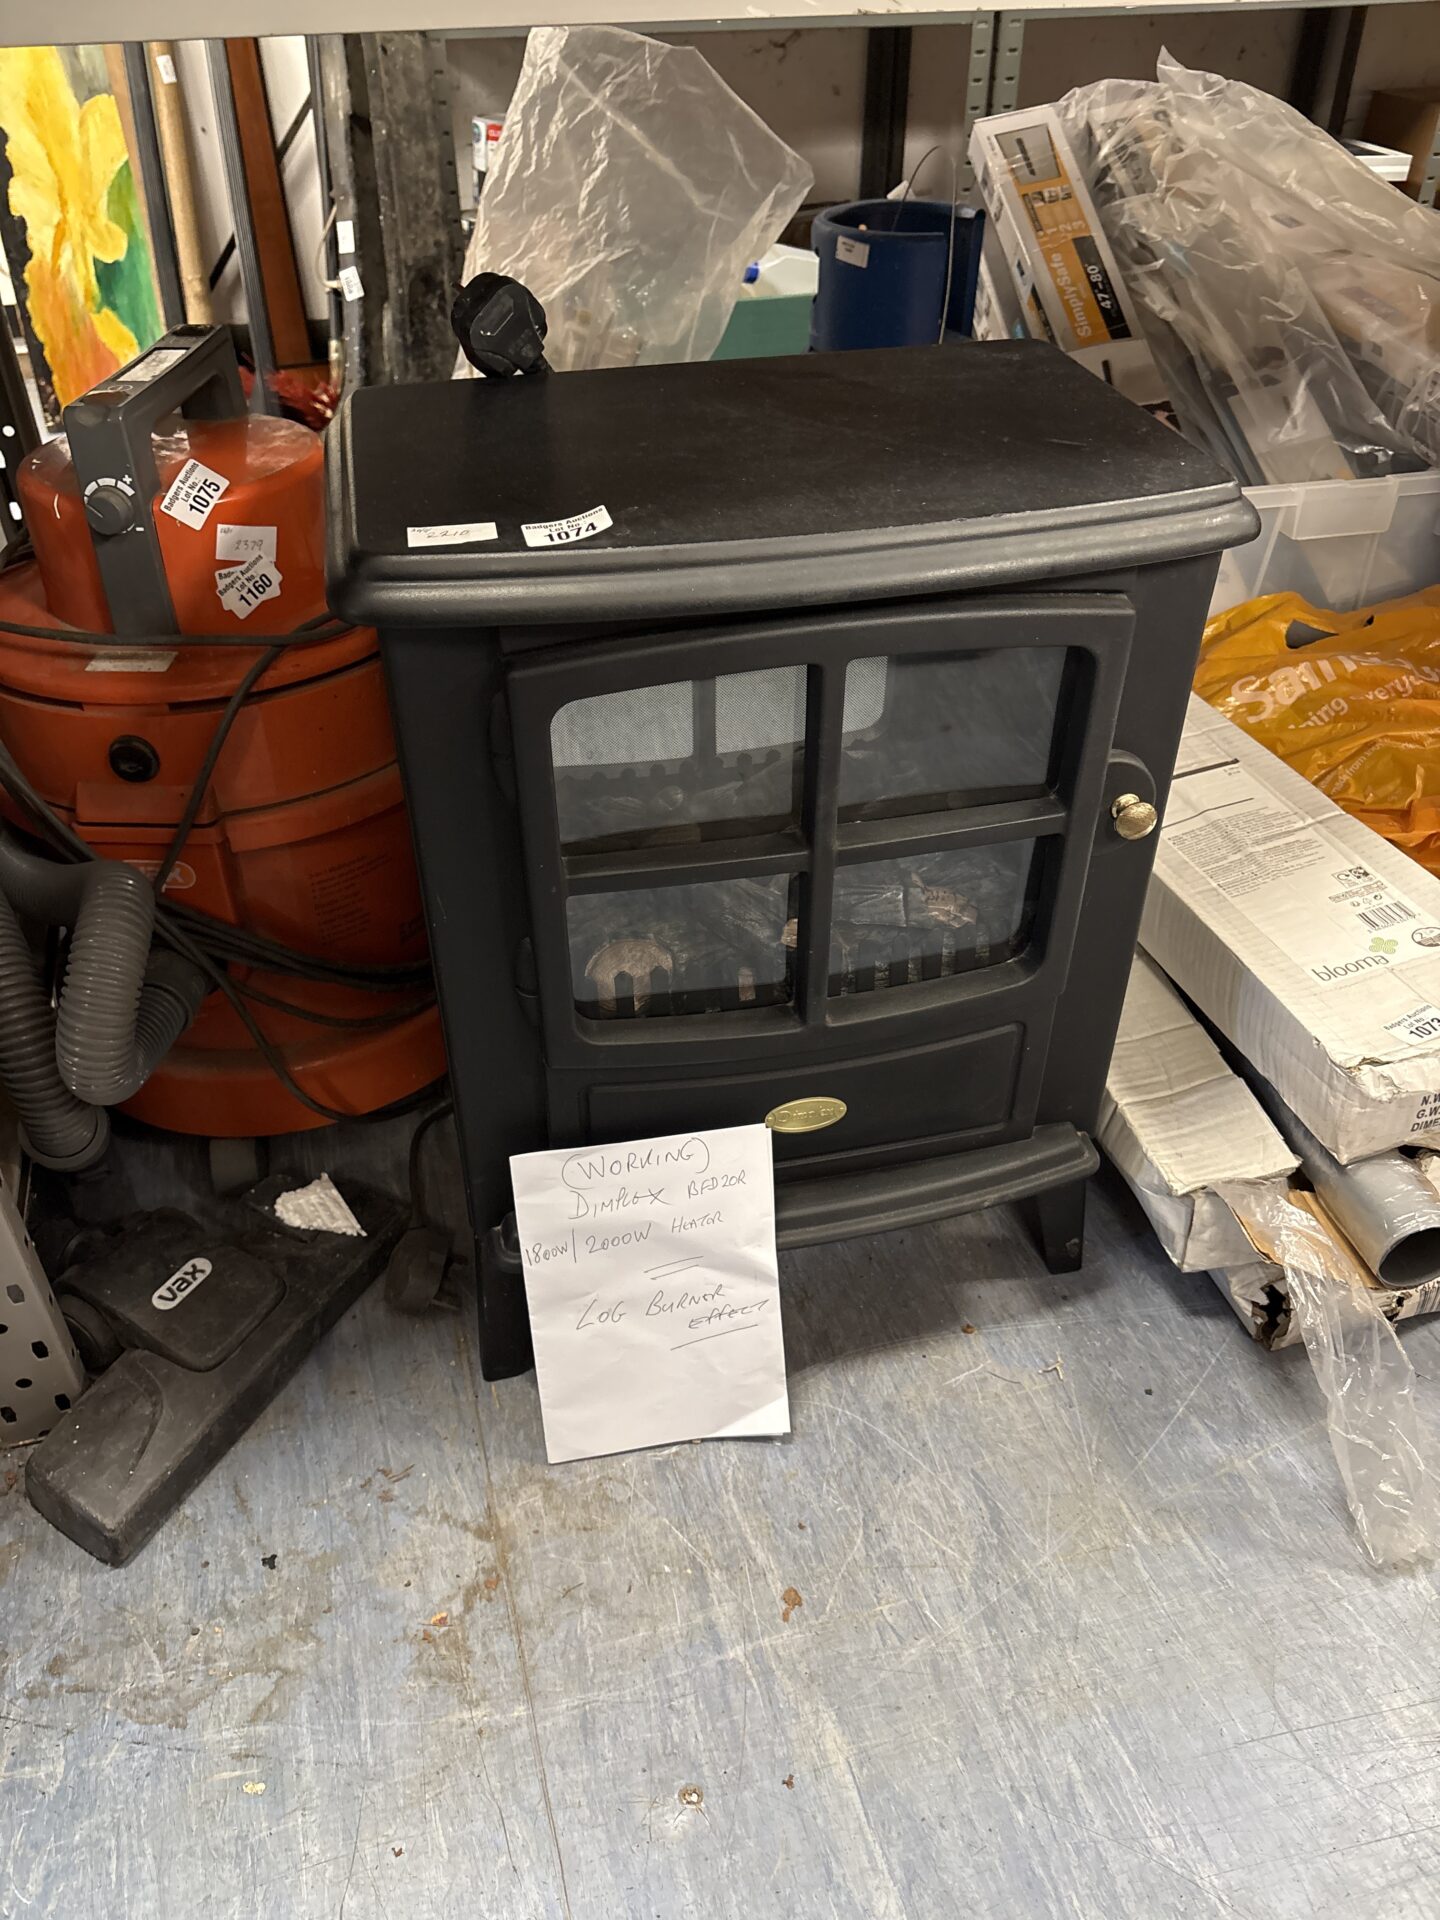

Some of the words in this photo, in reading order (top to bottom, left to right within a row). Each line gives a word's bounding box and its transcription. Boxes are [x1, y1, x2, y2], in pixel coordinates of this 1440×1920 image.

[1051, 252, 1092, 338] SimplySafe
[164, 484, 184, 512] Badgers
[181, 462, 200, 486] Auctions
[181, 488, 193, 502] Lot
[189, 478, 221, 515] 1075
[525, 522, 562, 530] Badgers
[566, 507, 603, 524] Auctions
[544, 522, 598, 542] 1074
[218, 573, 241, 597] Badgers
[240, 553, 264, 577] Auctions
[235, 581, 248, 592] Lot
[239, 573, 273, 607] 1160
[1312, 955, 1390, 983] blooma
[157, 1263, 206, 1302] vax
[576, 1299, 626, 1330] LOG
